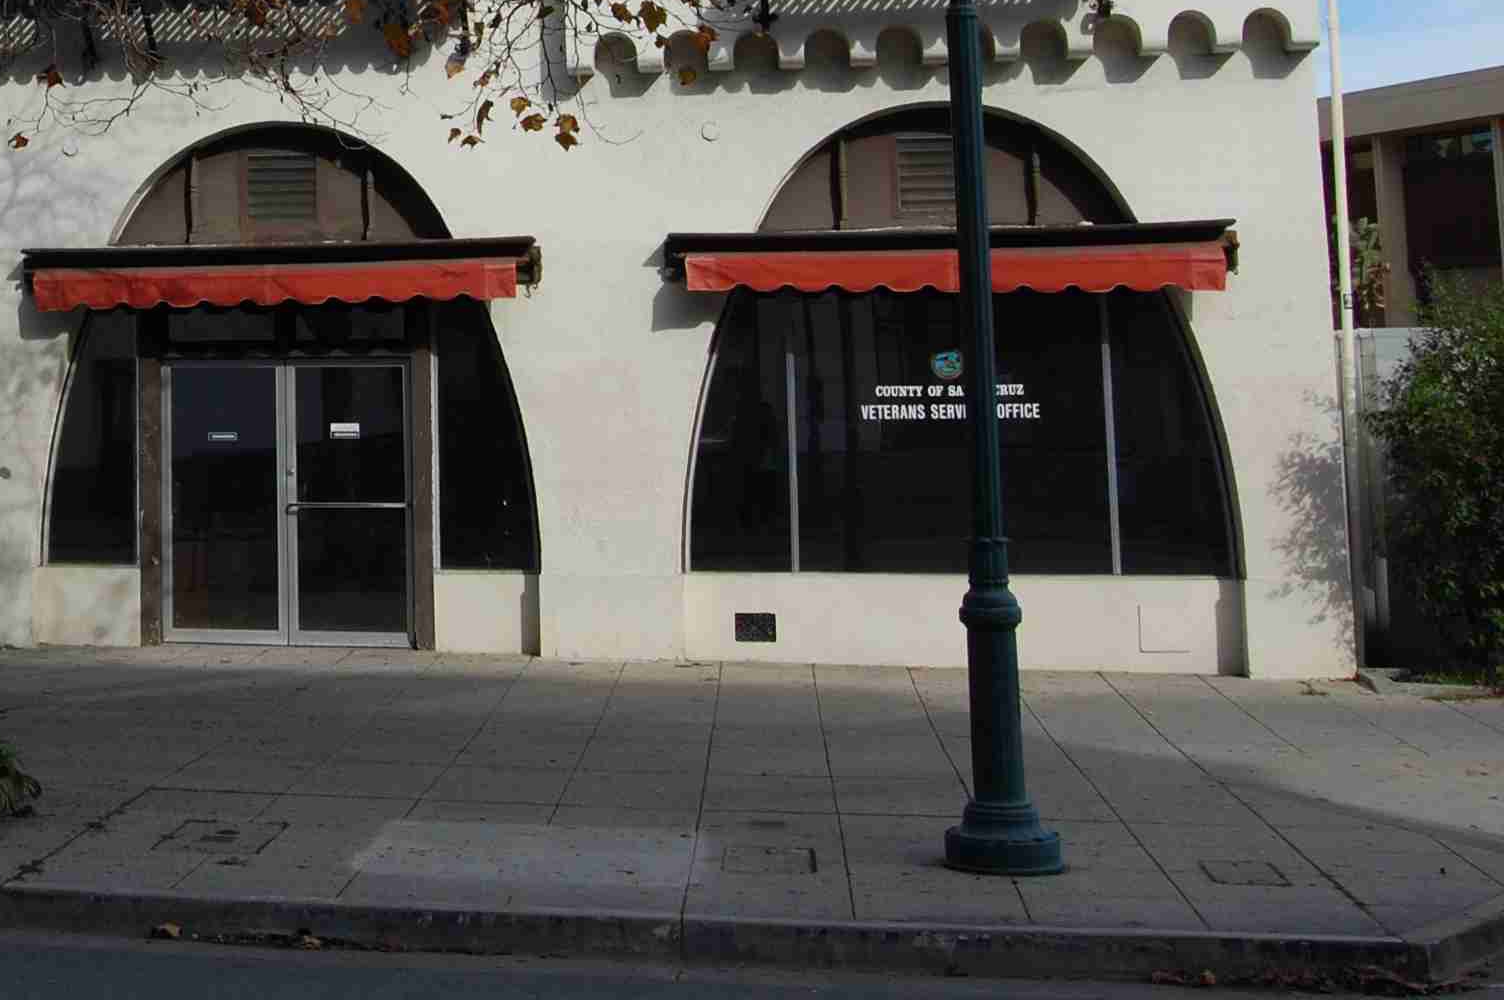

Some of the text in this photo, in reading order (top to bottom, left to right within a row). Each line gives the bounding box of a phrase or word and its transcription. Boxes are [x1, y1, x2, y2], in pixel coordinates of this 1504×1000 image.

[875, 385, 923, 397] COUNTY
[928, 385, 944, 397] OF
[861, 403, 1041, 420] VETERANS SERVI OFFICE
